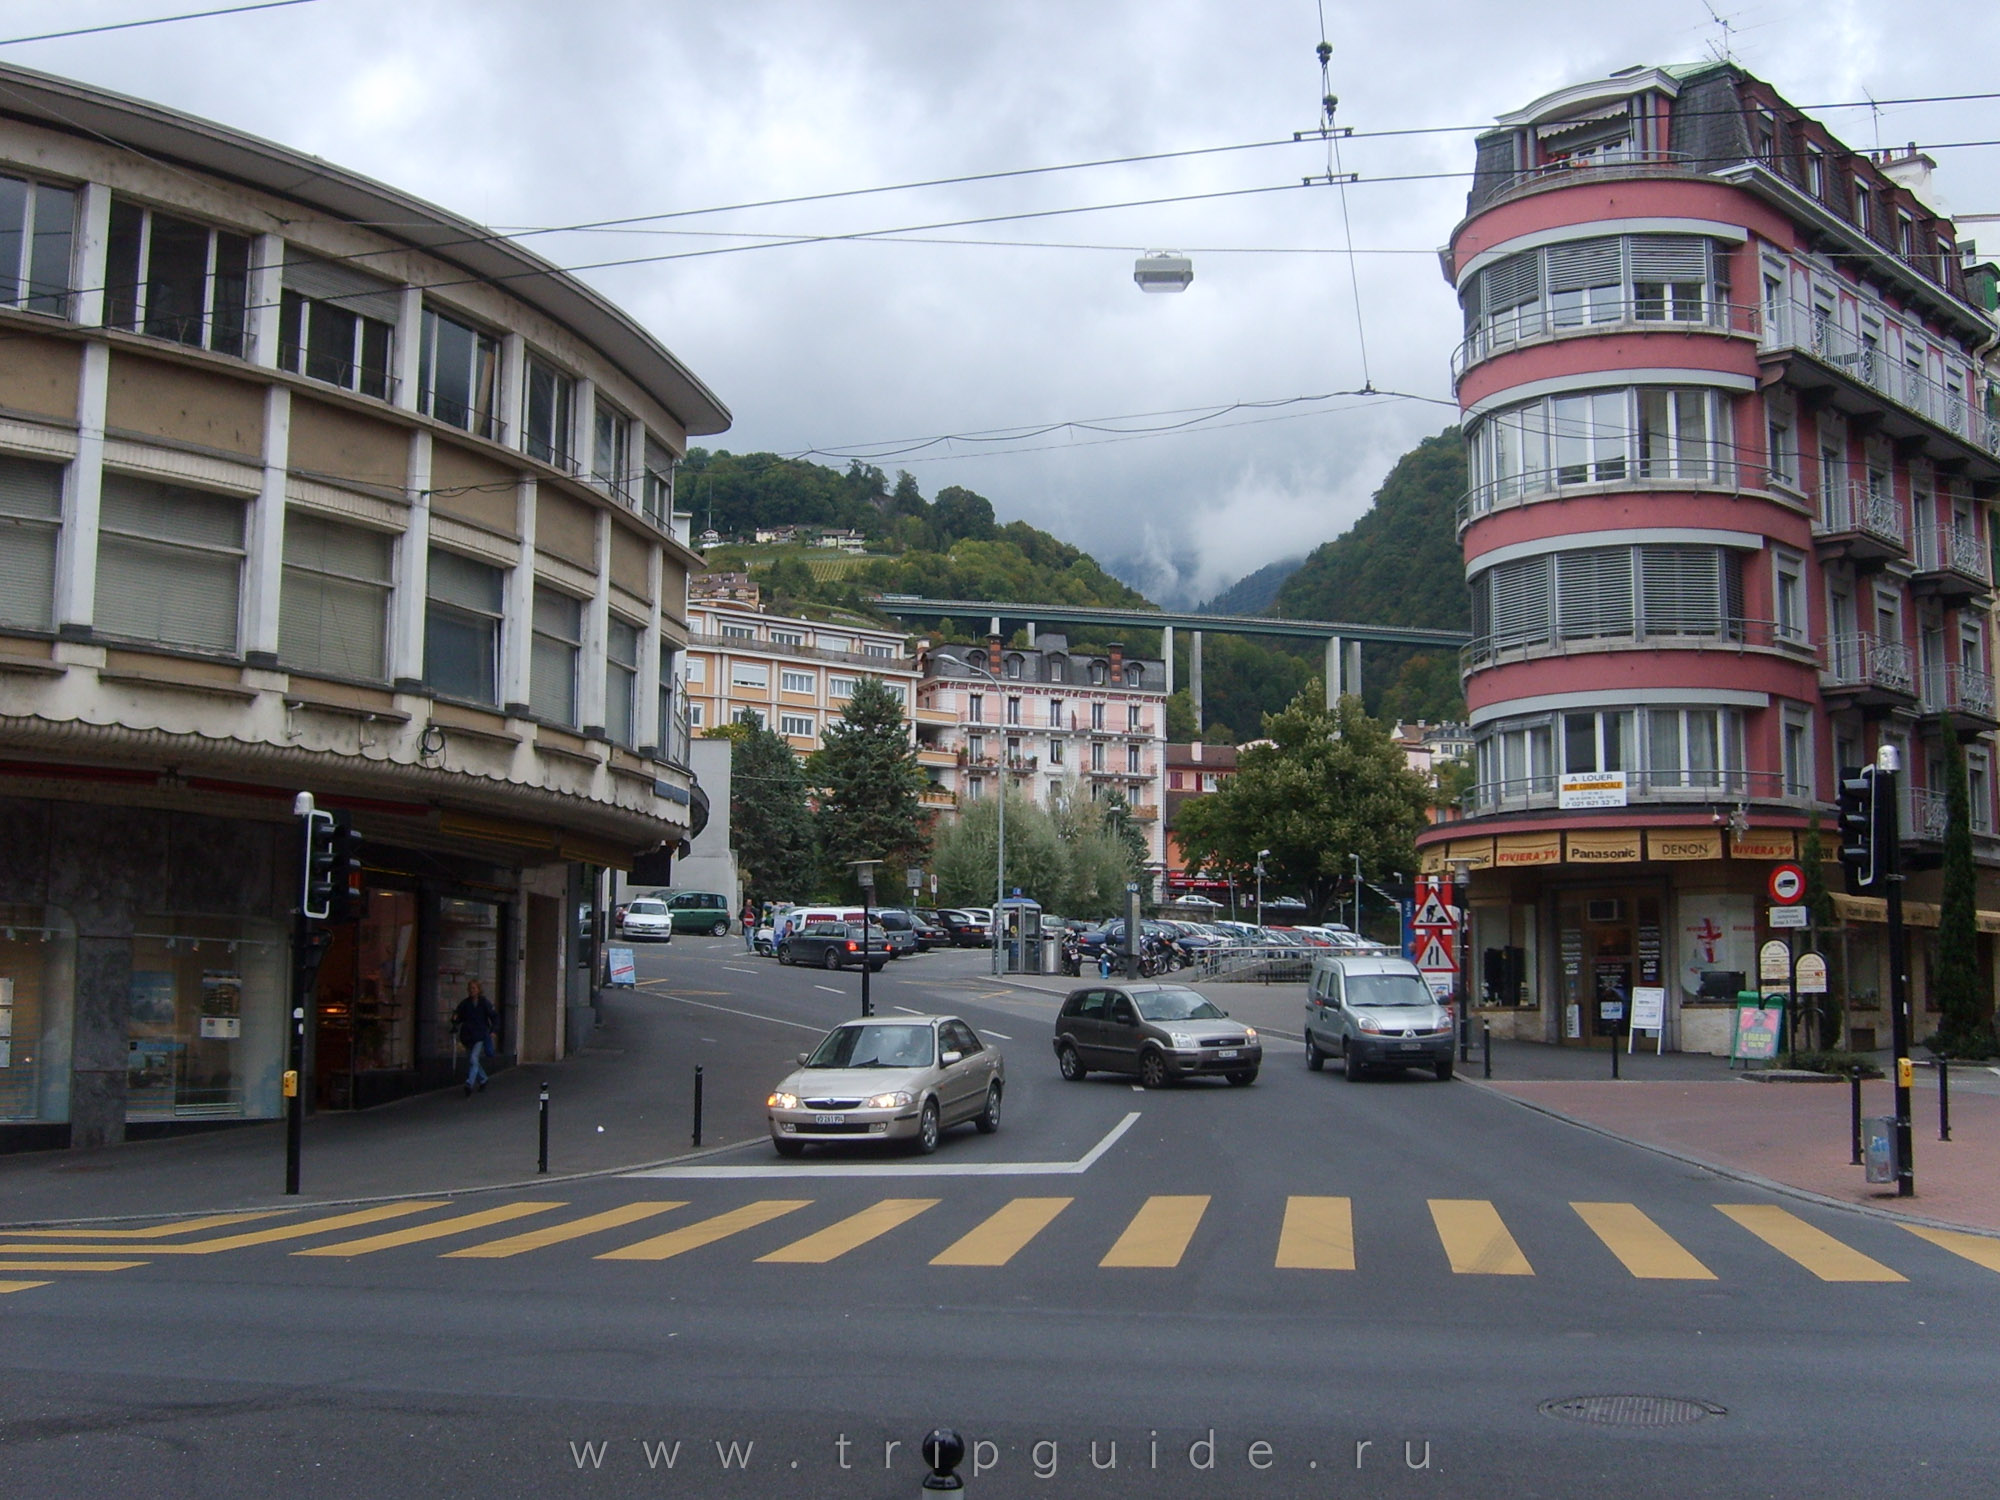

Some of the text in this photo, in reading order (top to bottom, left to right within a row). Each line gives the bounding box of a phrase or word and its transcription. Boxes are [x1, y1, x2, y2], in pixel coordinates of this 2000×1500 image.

[1582, 774, 1613, 782] LOUER
[1571, 847, 1636, 859] Panasonic
[1662, 844, 1708, 855] DENON
[1732, 844, 1793, 855] RIVIERA TV
[1498, 850, 1559, 862] RIVIERA TV
